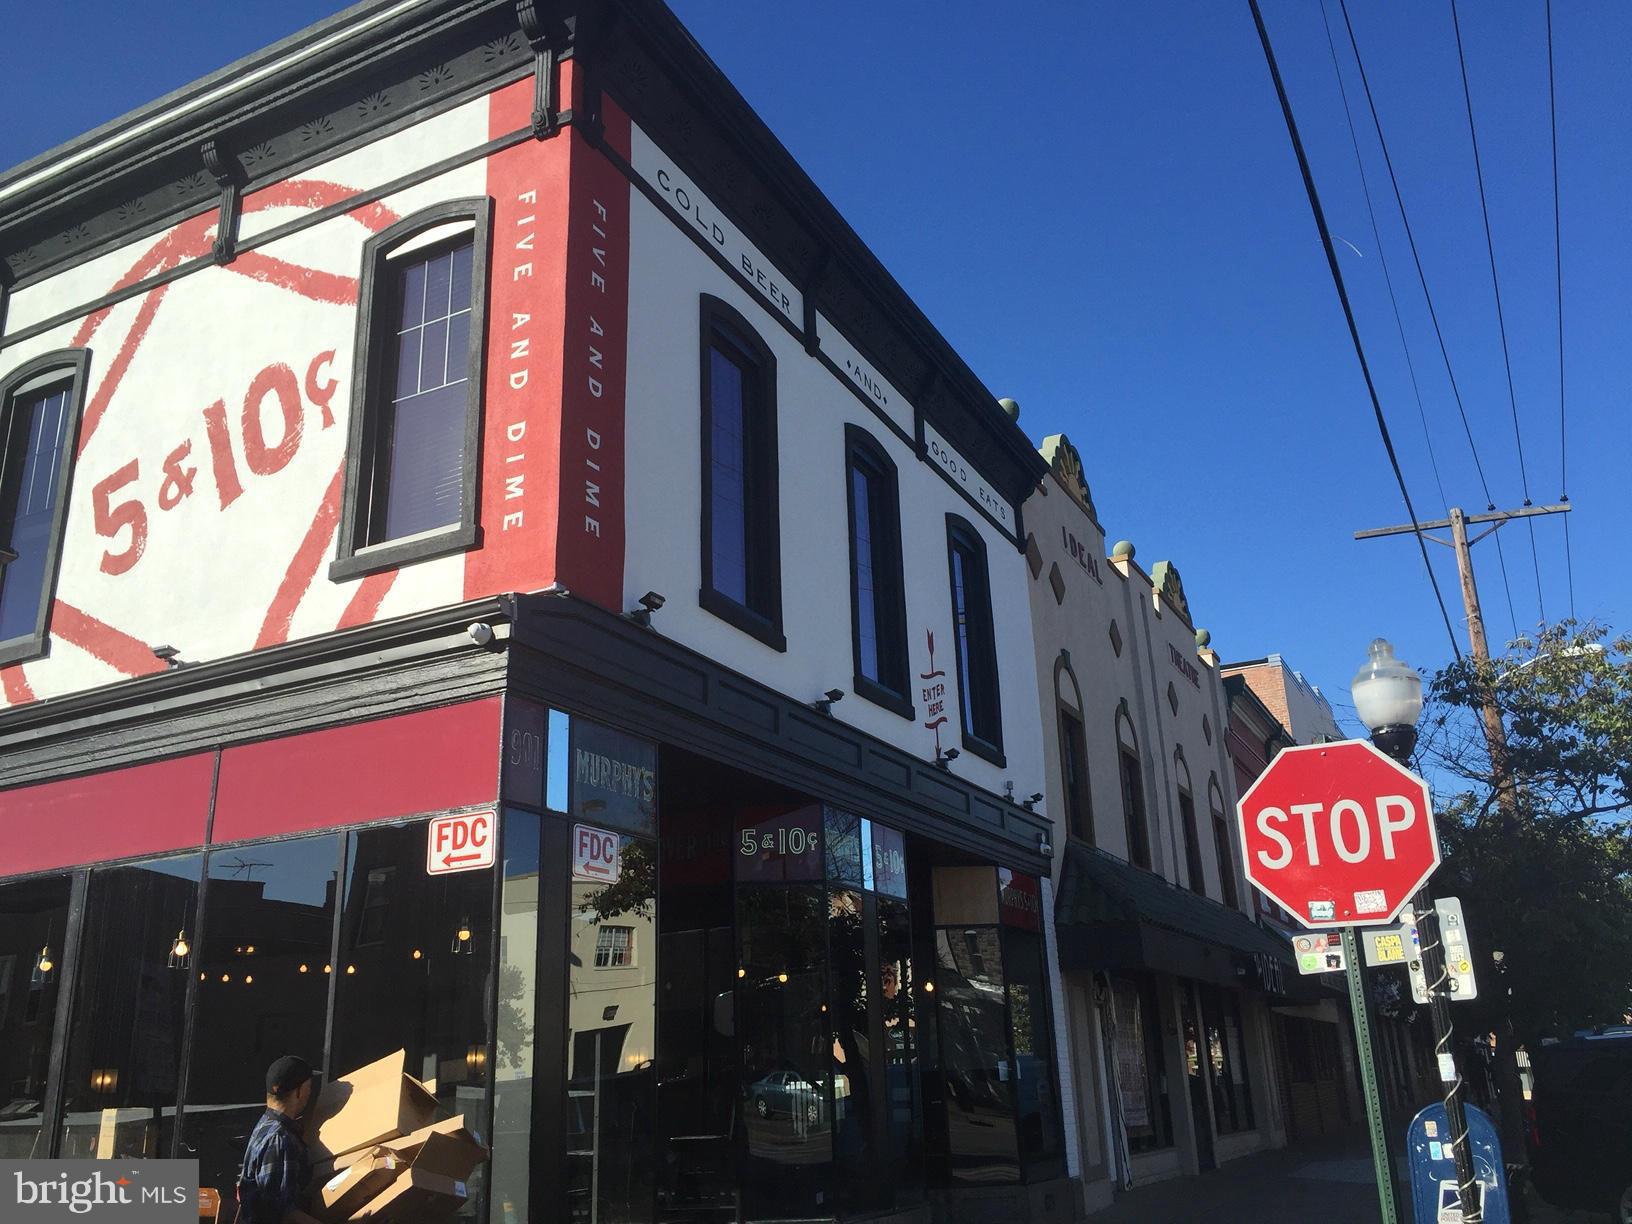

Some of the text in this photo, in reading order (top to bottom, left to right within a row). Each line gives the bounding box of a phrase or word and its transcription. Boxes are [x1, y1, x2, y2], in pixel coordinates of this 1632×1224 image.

[656, 168, 792, 315] COLD BEER
[502, 189, 537, 532] FIVE AND DIME
[584, 198, 609, 539] FIVE AND DIME
[853, 364, 883, 402] AND
[931, 440, 1008, 521] GOOD EATS
[1061, 525, 1104, 586] IDEAL
[922, 683, 946, 702] ENTER
[927, 699, 944, 715] HERE
[511, 728, 543, 772] 901
[576, 748, 655, 801] MURPHY'S
[436, 817, 488, 853] FDC
[578, 830, 614, 864] FDC
[1255, 794, 1417, 870] STOP
